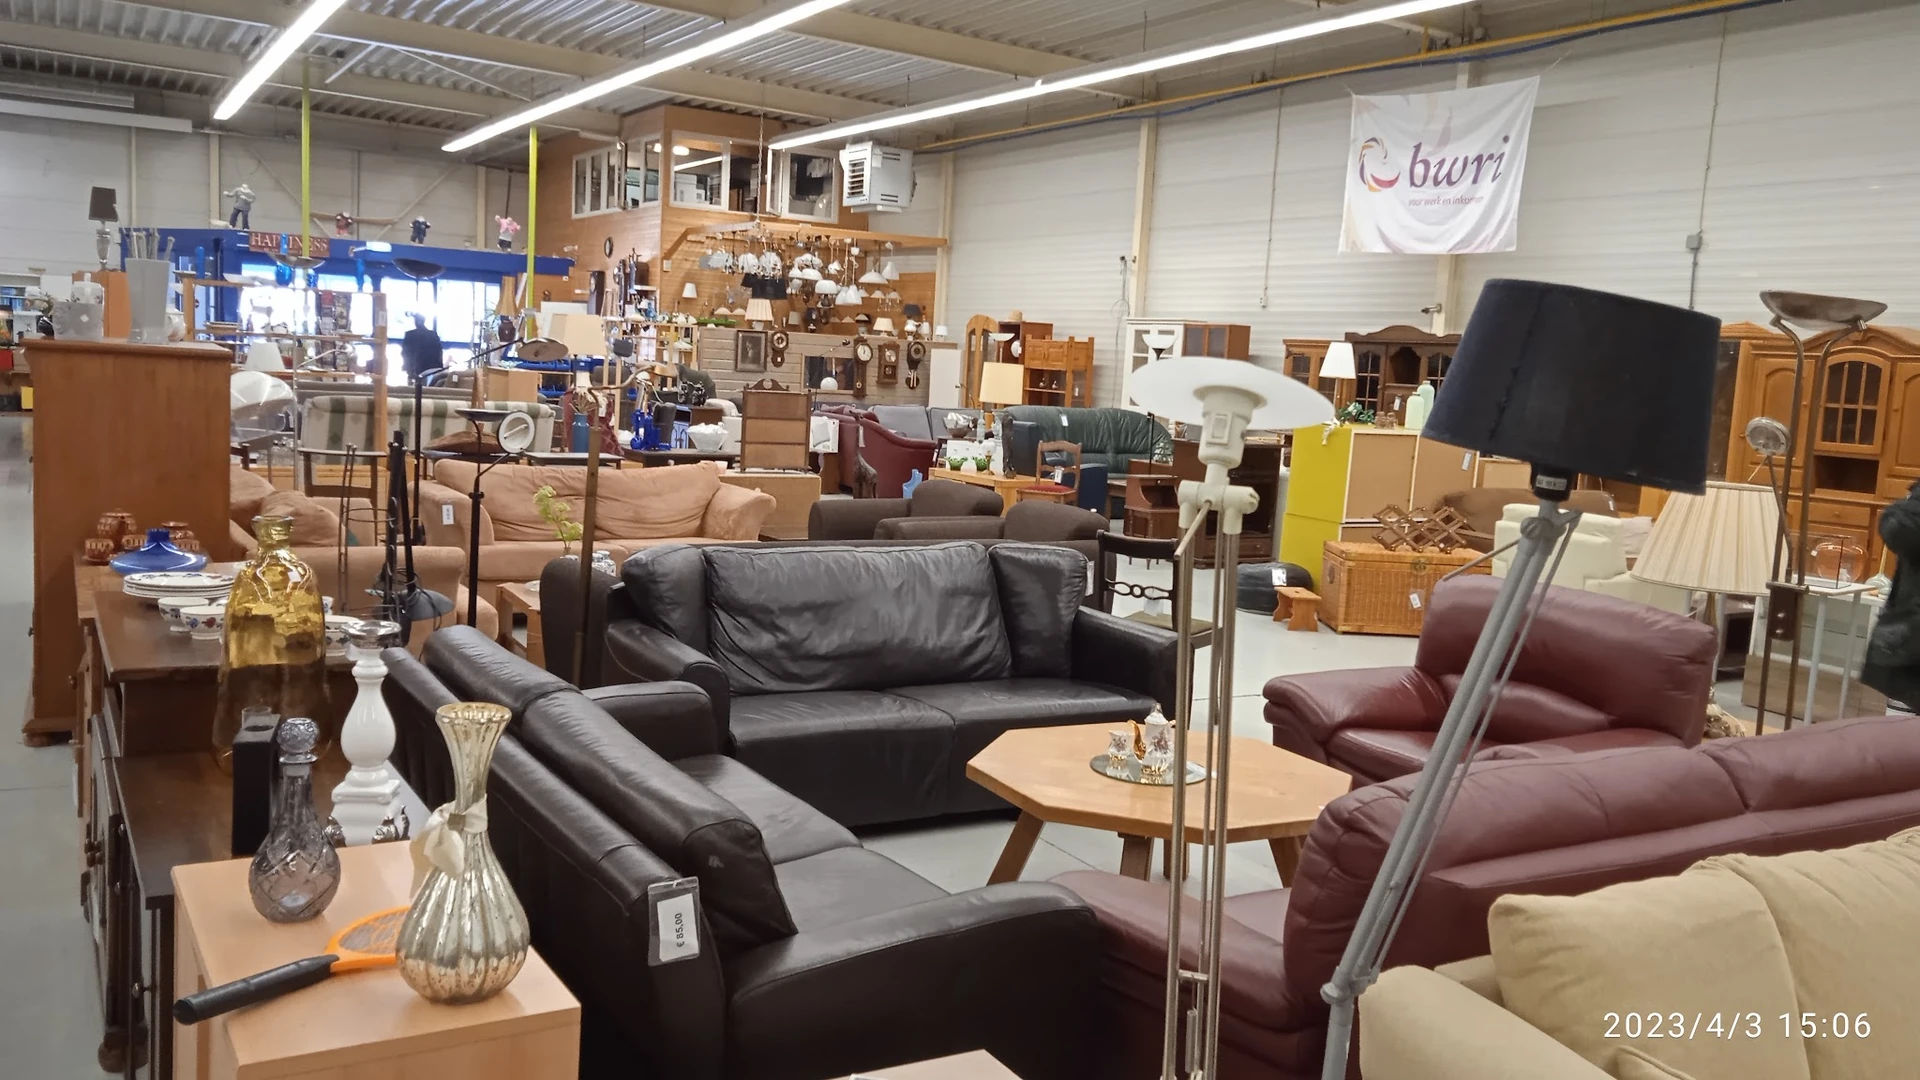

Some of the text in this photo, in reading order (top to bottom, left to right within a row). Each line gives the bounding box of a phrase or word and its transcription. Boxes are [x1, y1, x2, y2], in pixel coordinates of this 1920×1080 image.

[1409, 135, 1510, 189] bwri
[1424, 196, 1442, 206] werk
[251, 232, 328, 252] HAPINSS
[675, 912, 685, 948] € 85.00
